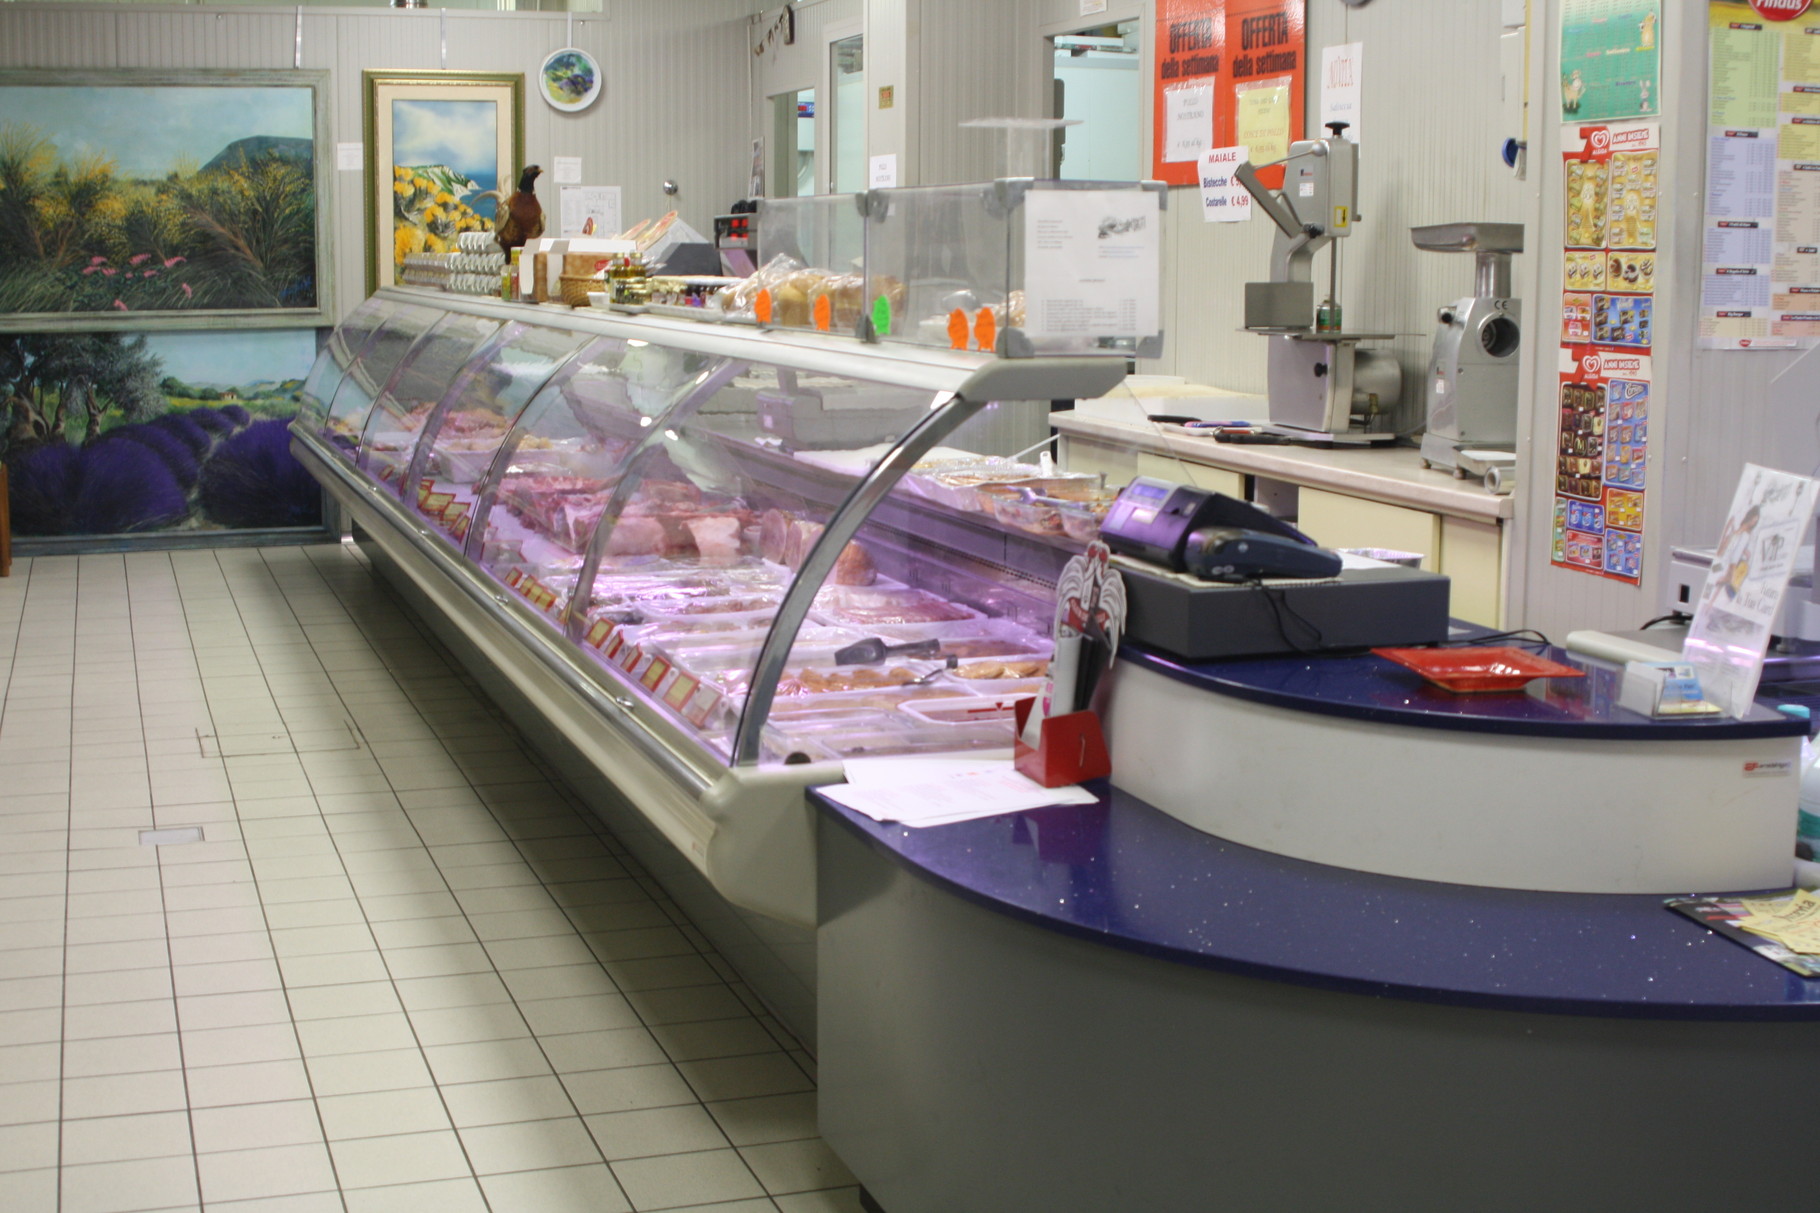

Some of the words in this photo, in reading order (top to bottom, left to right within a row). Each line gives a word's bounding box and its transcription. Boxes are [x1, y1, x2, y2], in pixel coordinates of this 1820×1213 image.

[1169, 18, 1212, 54] OFFERTA
[1241, 11, 1289, 51] OFFERTA
[1161, 57, 1180, 79] della
[1182, 54, 1219, 77] settimana
[1233, 54, 1253, 78] della
[1256, 50, 1297, 76] settimana
[1208, 152, 1237, 164] MAIALE
[1203, 176, 1228, 188] Bistecche
[1236, 195, 1249, 208] 4,99
